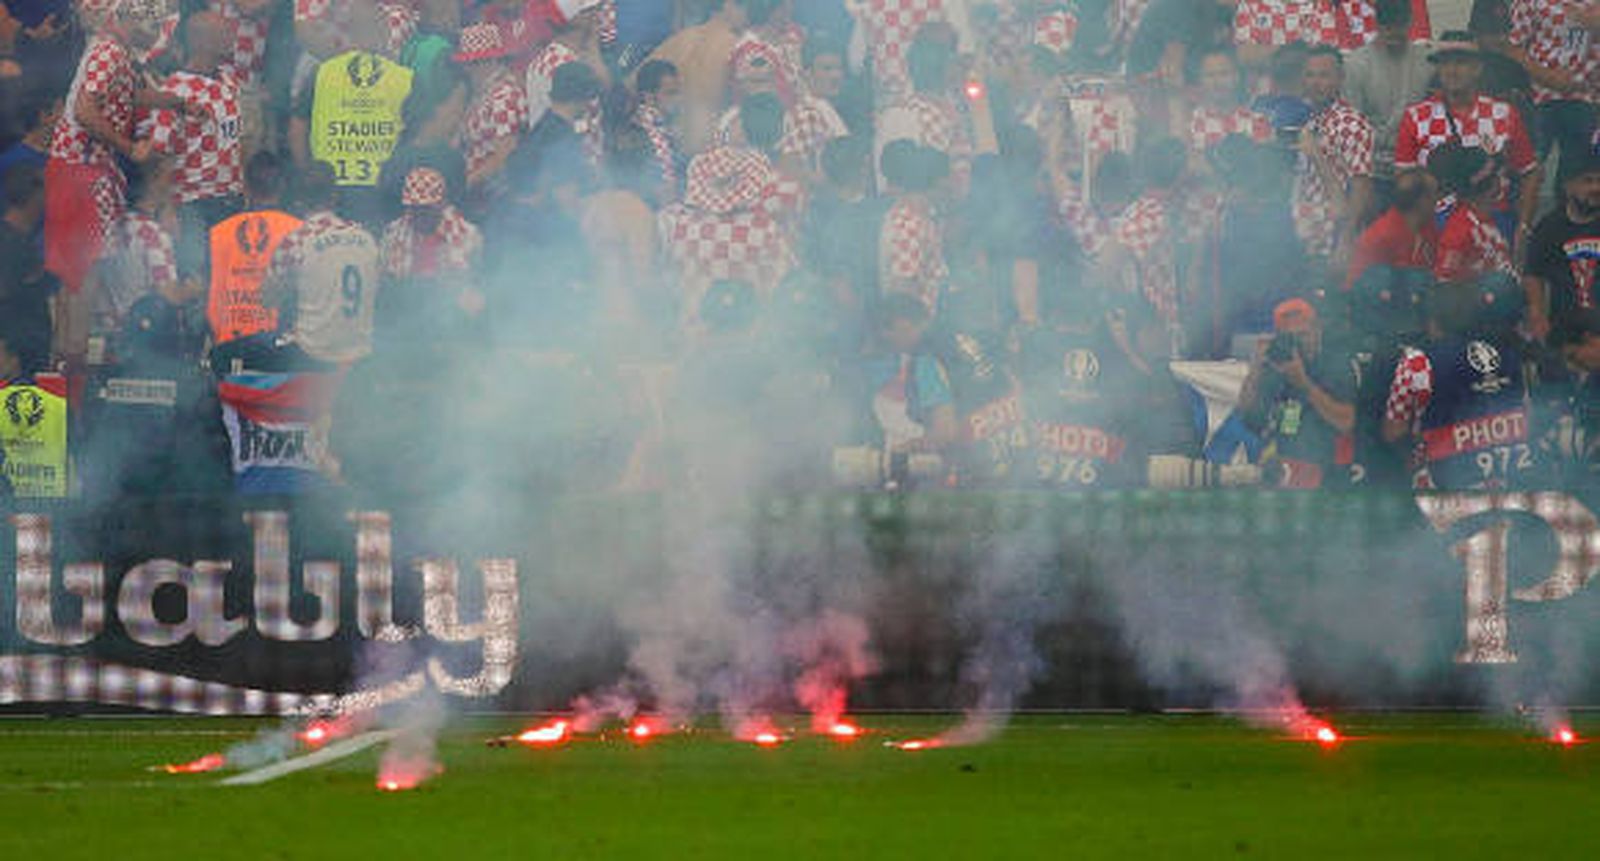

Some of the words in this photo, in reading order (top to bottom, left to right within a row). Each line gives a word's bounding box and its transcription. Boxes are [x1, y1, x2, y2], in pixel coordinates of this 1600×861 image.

[336, 159, 371, 180] 13
[342, 264, 362, 318] 9
[1036, 457, 1098, 485] 976
[1476, 443, 1532, 478] 972
[9, 510, 520, 697] bably
